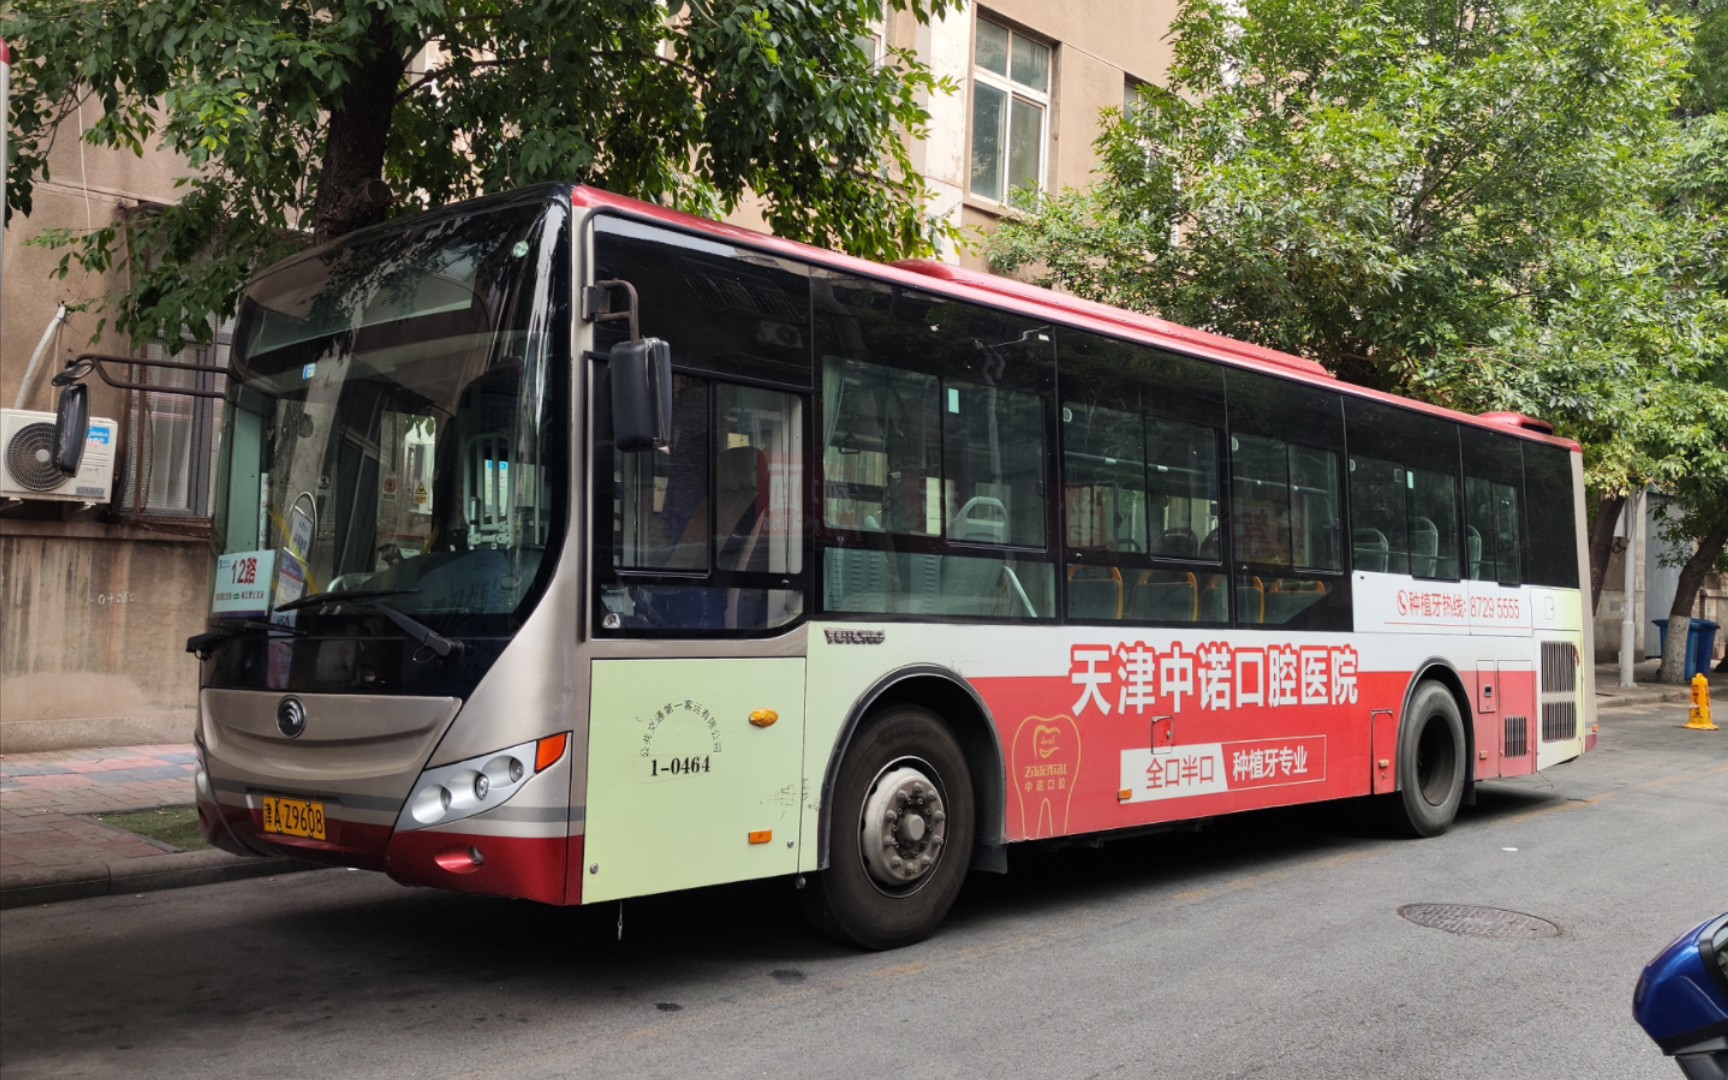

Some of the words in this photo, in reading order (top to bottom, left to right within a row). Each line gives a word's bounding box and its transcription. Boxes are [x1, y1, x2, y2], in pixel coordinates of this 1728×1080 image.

[231, 556, 258, 585] 12路
[1470, 596, 1495, 618] 8729
[1497, 597, 1520, 619] 5555
[1070, 645, 1359, 717] 天津中诺口腔医院
[650, 755, 711, 777] 1-0464
[1145, 754, 1215, 790] 全口半口
[1232, 745, 1309, 783] 种植牙专业
